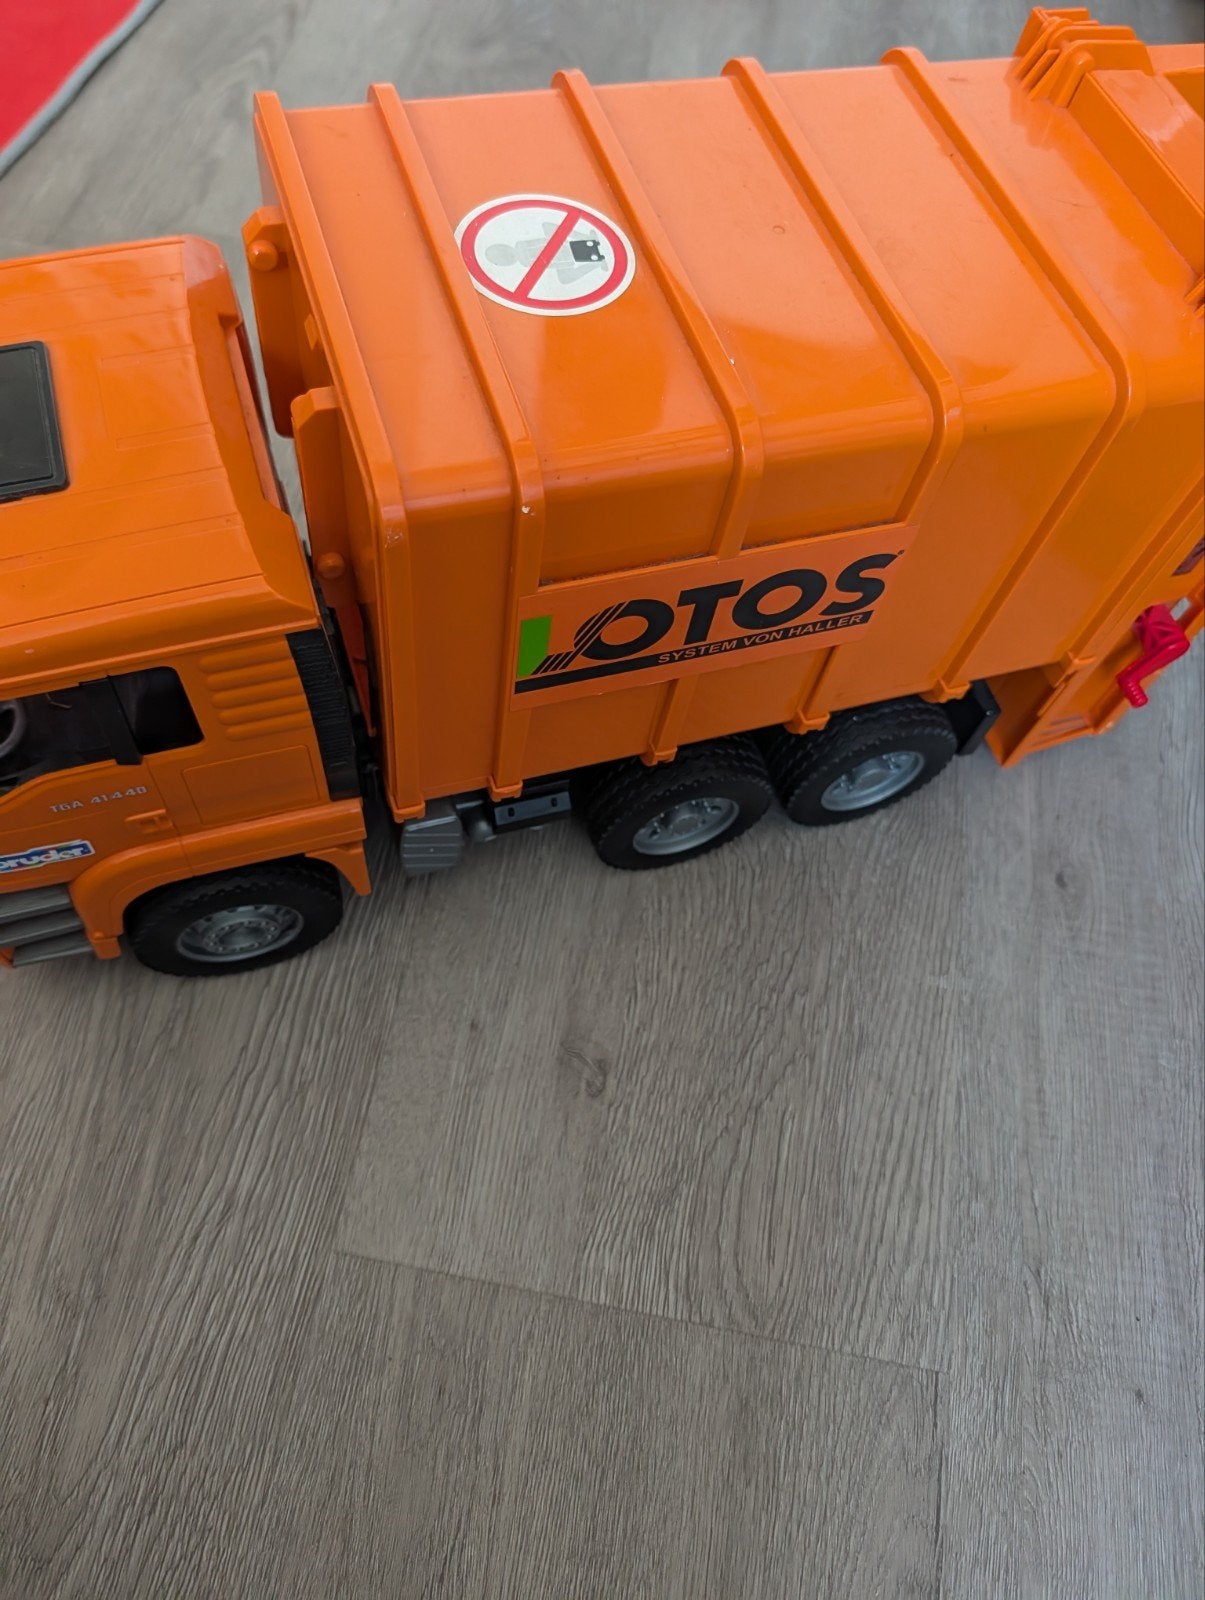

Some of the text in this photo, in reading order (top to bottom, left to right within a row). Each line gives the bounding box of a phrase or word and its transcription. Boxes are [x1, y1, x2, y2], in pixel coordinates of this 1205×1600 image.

[658, 614, 863, 663] SYSTEM VON HALLER
[50, 800, 84, 812] TGA
